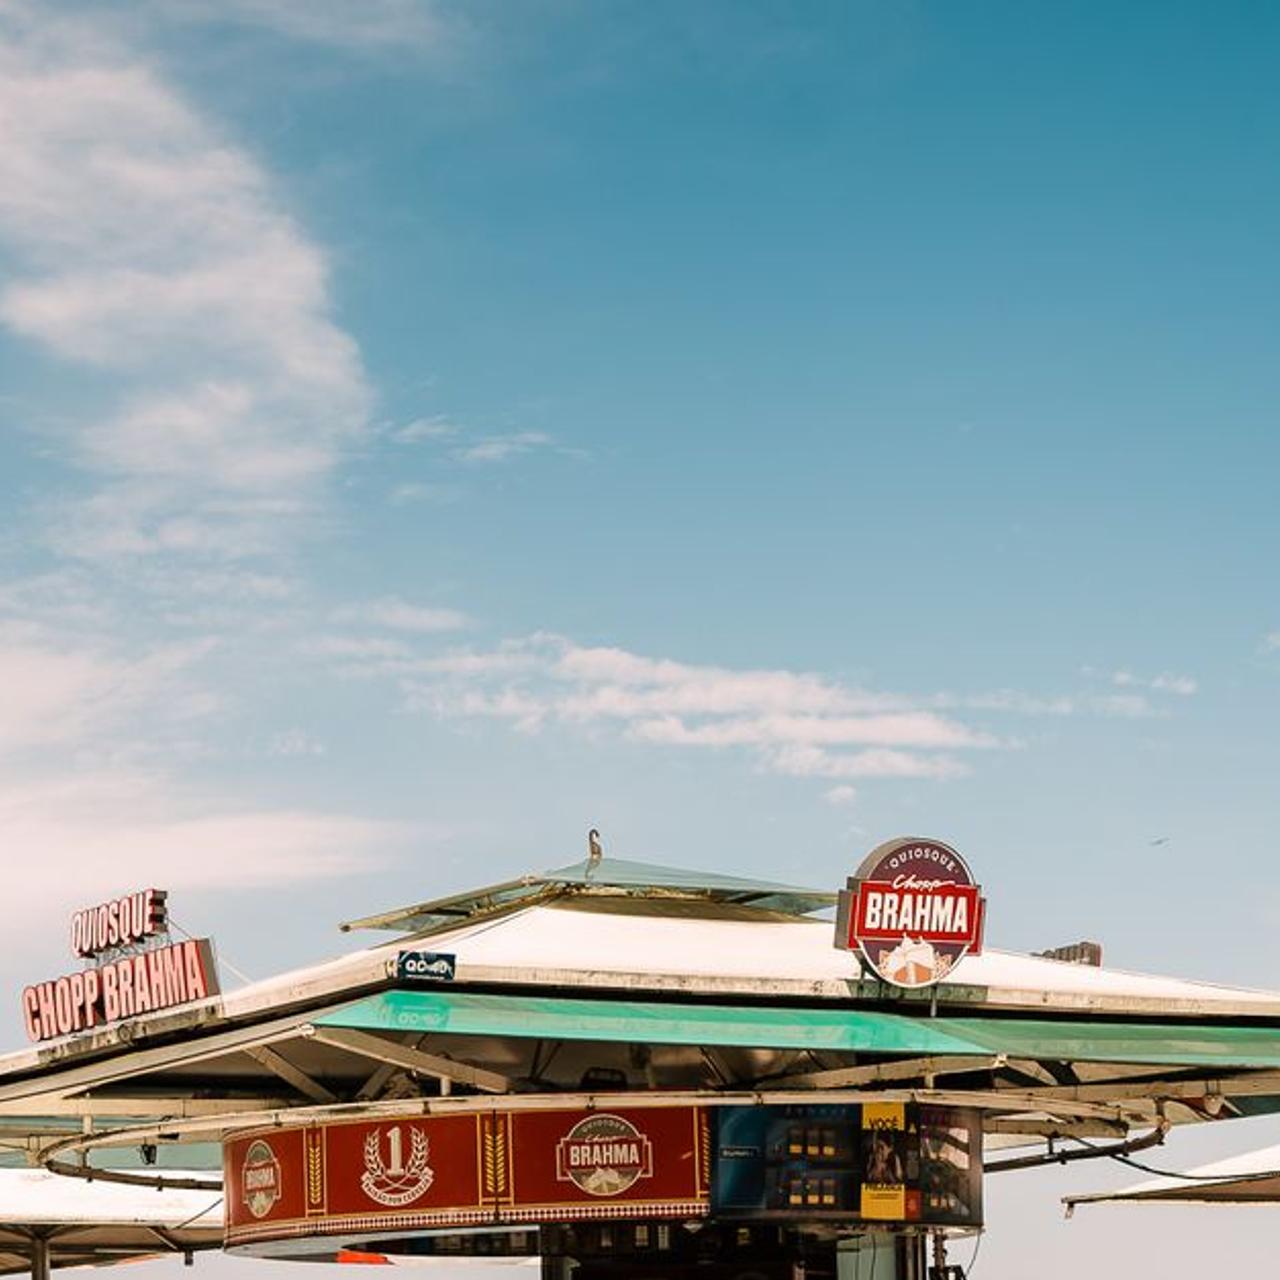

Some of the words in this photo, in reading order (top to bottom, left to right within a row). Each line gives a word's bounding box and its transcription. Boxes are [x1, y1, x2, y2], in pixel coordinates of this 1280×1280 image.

[889, 847, 955, 872] QUIOSQUE
[71, 890, 155, 958] QUIOSQUE
[865, 891, 968, 933] BRAHMA
[23, 970, 99, 1042] CHOPP
[102, 940, 208, 1022] BRAHMA
[569, 1144, 640, 1166] BRAHMA
